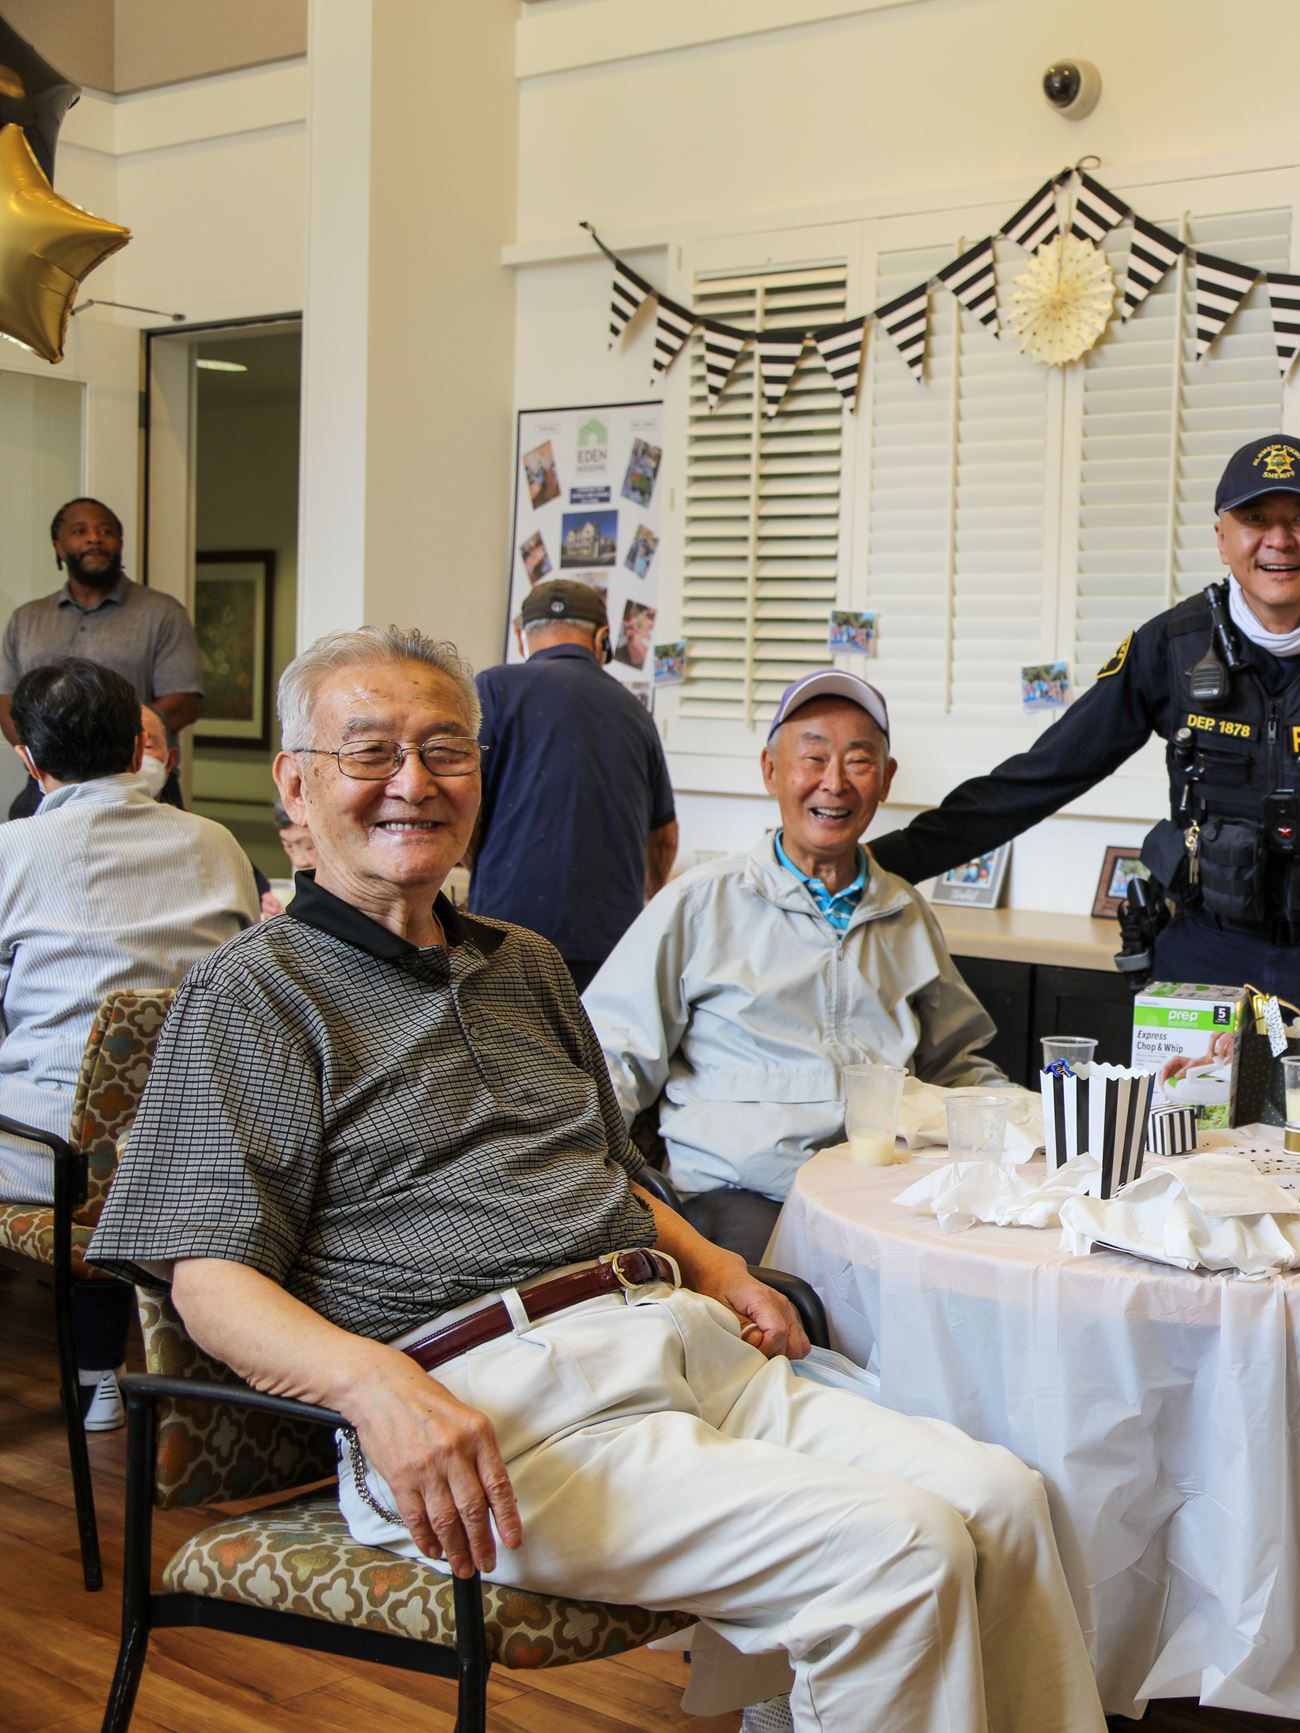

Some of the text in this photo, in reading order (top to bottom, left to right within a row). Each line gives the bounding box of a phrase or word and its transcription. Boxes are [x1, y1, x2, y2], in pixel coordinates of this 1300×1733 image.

[577, 448, 608, 464] EDEN
[1262, 471, 1295, 479] SHERIFF
[1187, 713, 1251, 737] DEP. 1878
[1167, 1010, 1199, 1021] prep
[1218, 1007, 1226, 1019] 5
[1137, 1030, 1168, 1041] Express
[1136, 1041, 1184, 1054] Chop & Whip
